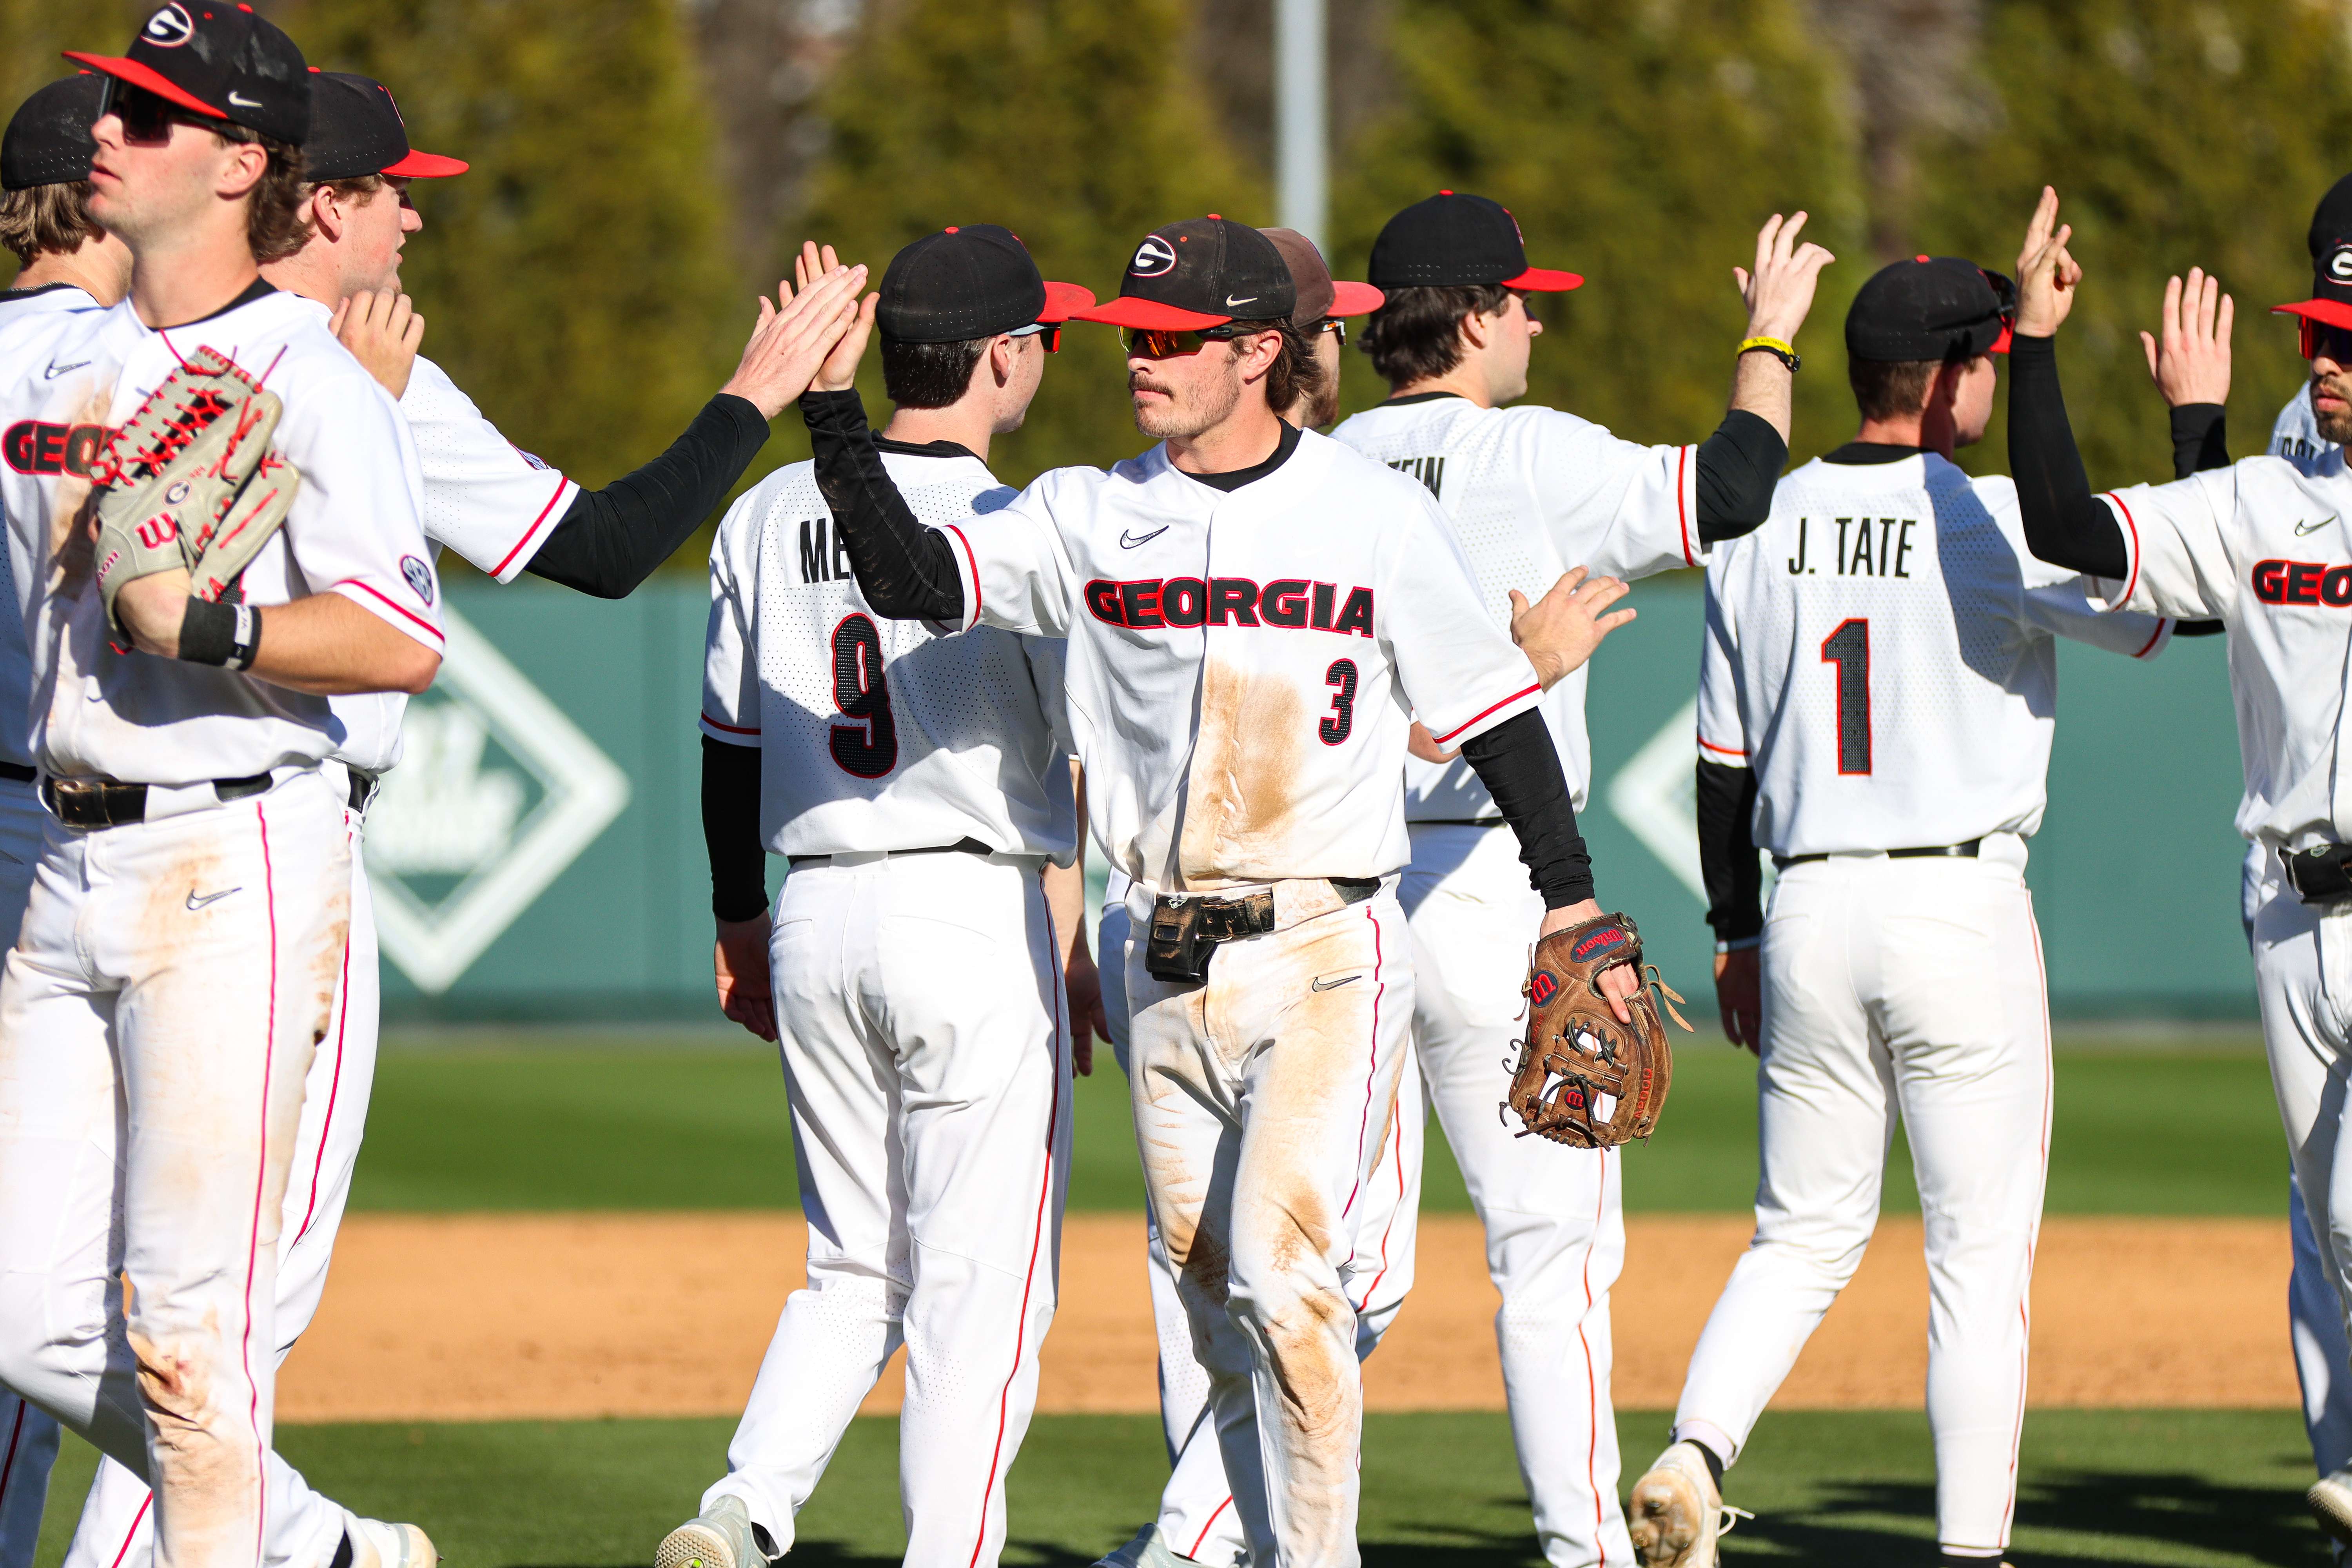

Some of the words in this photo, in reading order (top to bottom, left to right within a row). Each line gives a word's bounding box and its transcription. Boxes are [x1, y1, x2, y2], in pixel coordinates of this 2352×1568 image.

[2, 419, 120, 478] GEO
[134, 510, 177, 550] W
[800, 518, 853, 583] ME
[1789, 518, 1815, 575] J.
[1835, 518, 1916, 577] TATE
[1084, 577, 1373, 638] GEORGIA
[830, 612, 897, 779] 9
[1319, 658, 1358, 746] 3
[1822, 618, 1871, 775] 1
[1634, 1068, 1652, 1119] A2000
